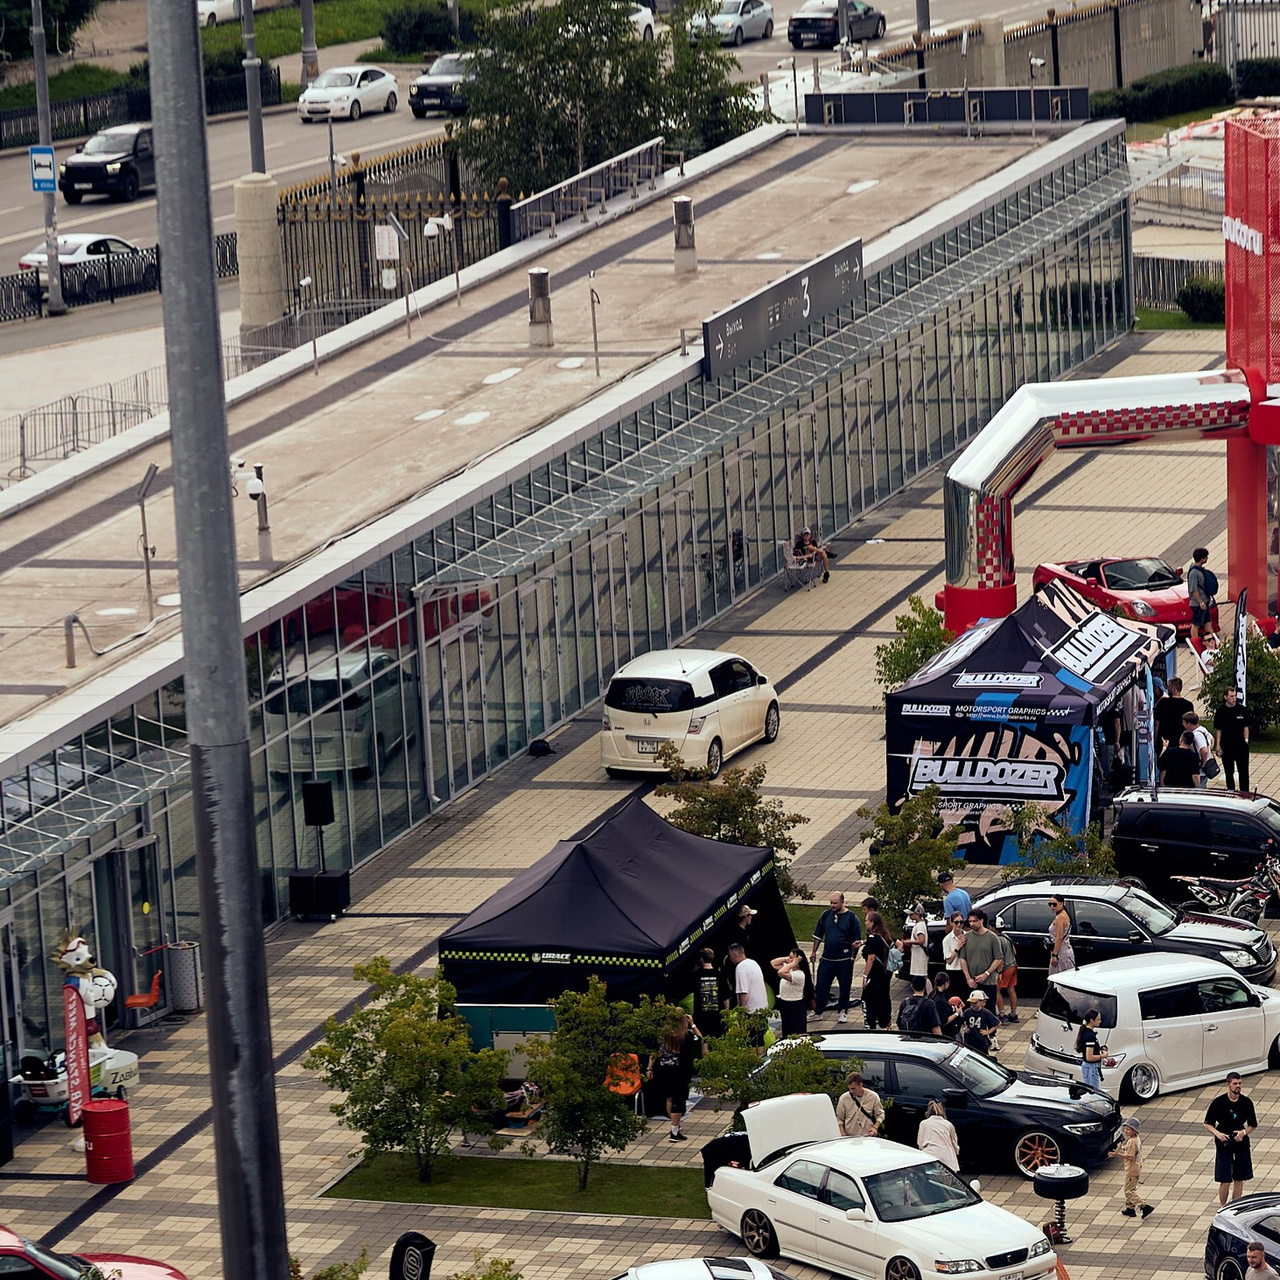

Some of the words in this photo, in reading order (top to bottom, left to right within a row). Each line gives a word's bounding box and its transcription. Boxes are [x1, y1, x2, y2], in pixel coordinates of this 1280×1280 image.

[1222, 216, 1264, 256] auto.ru
[801, 276, 811, 318] 3
[956, 673, 1039, 687] BULLDOZER
[902, 703, 951, 717] BULLDOZER
[955, 704, 1006, 715] MOTORSPORT
[1007, 706, 1047, 717] GRAPHICS
[914, 759, 1058, 796] BULLDOZER
[968, 1016, 982, 1029] 94
